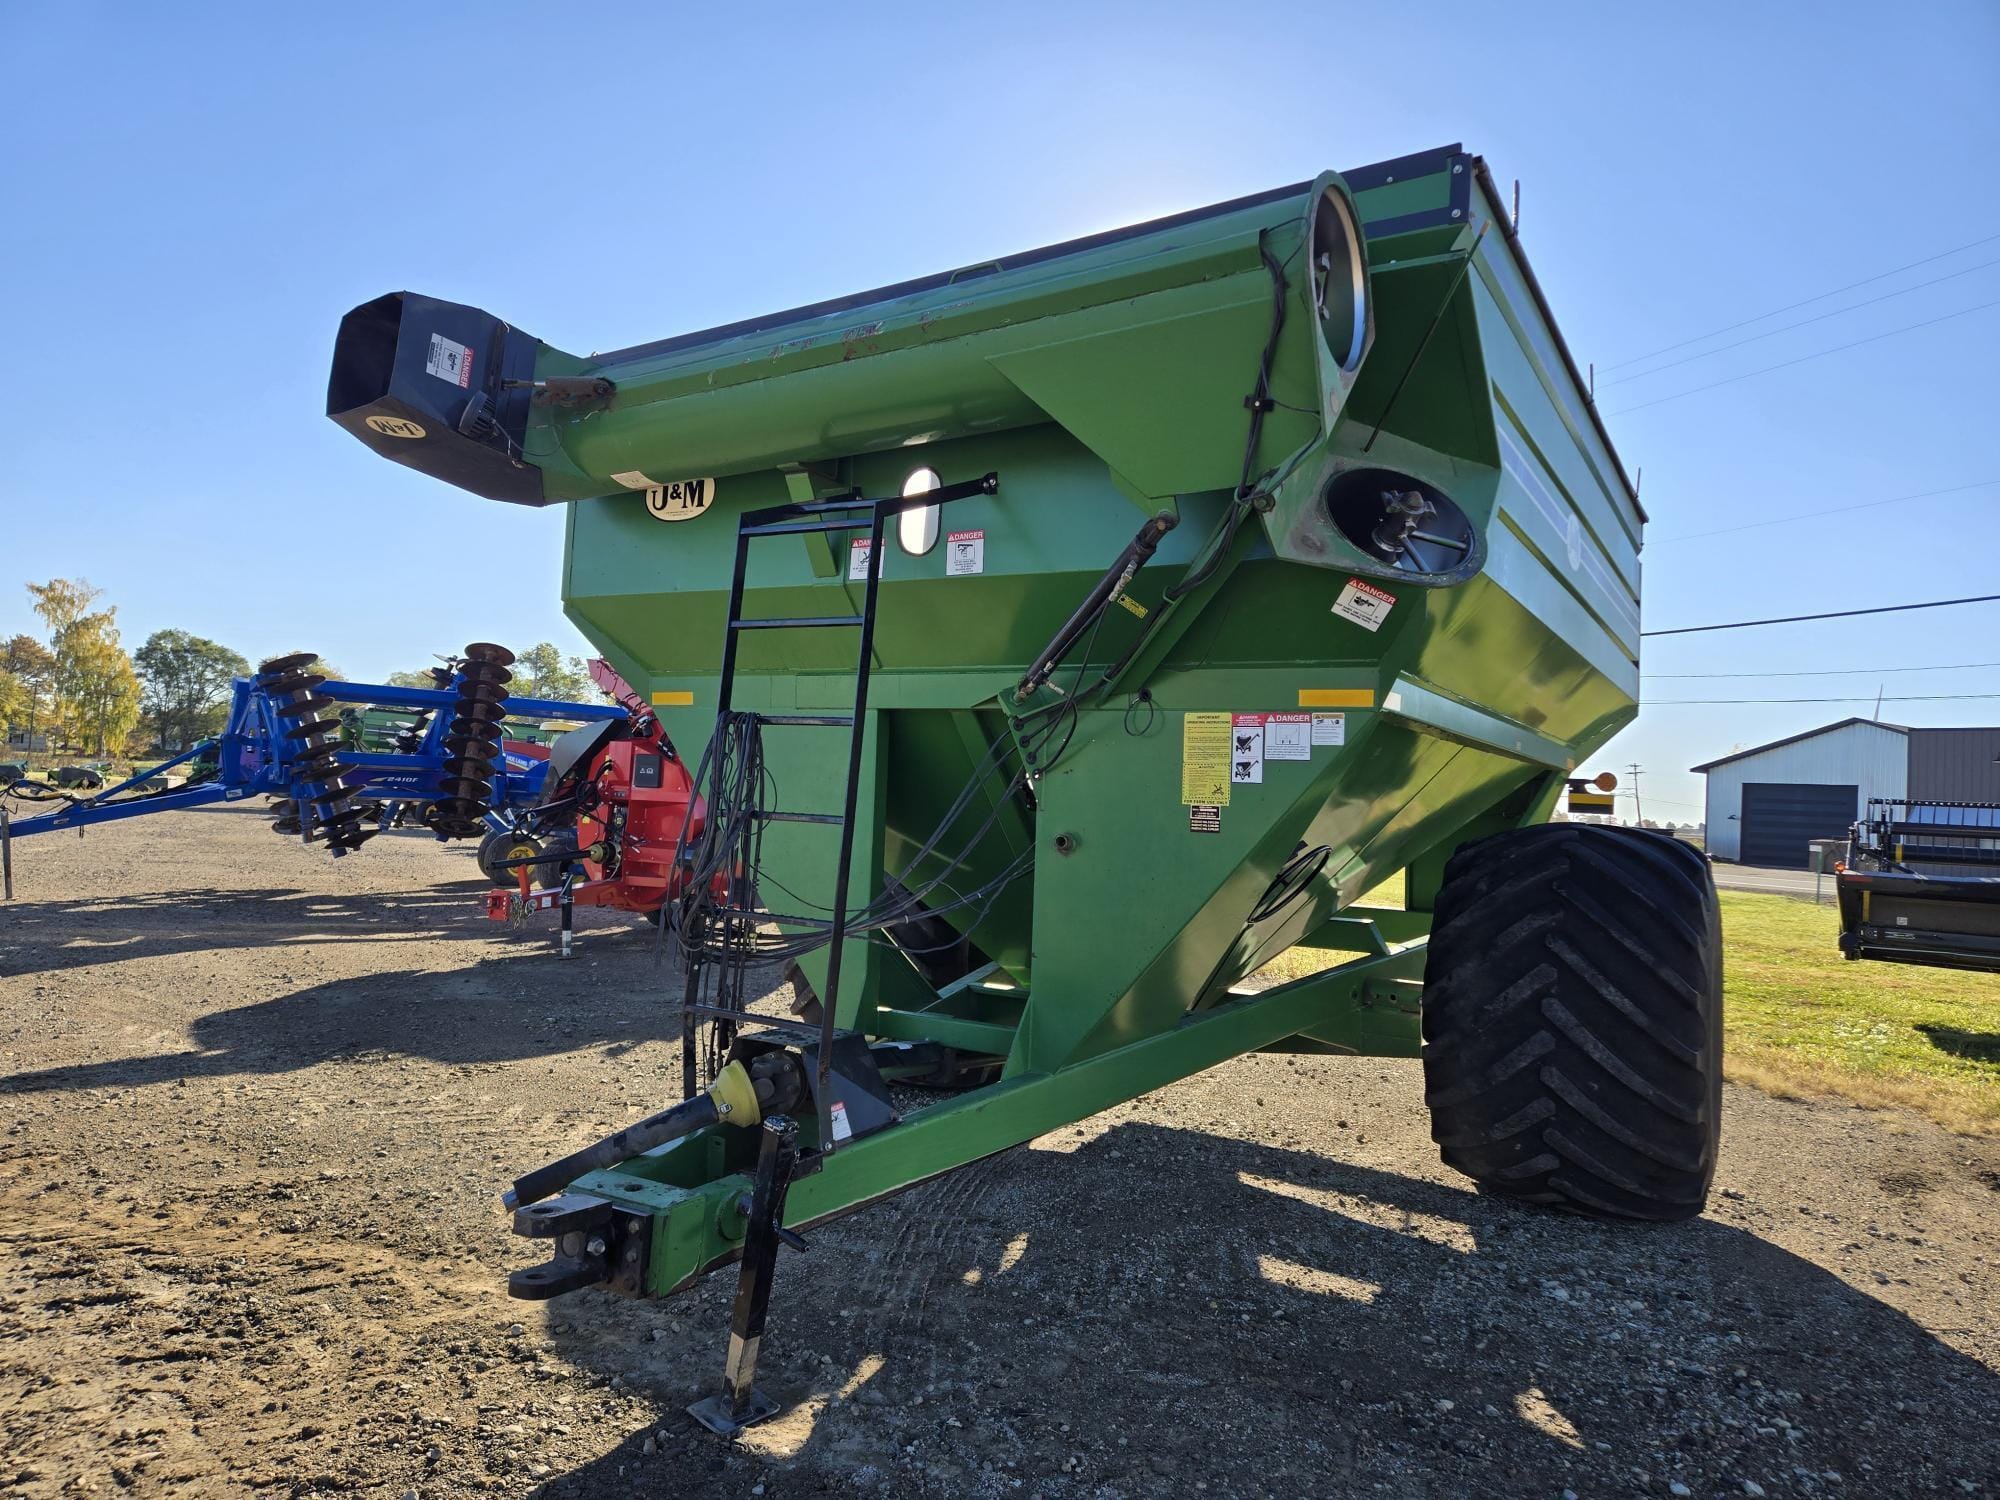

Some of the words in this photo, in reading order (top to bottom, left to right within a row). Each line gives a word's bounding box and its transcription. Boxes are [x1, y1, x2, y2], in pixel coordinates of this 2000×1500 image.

[459, 353, 473, 388] DANGER
[954, 531, 984, 541] DANGER
[1357, 582, 1397, 604] DANGER
[1276, 714, 1311, 722] DANGER
